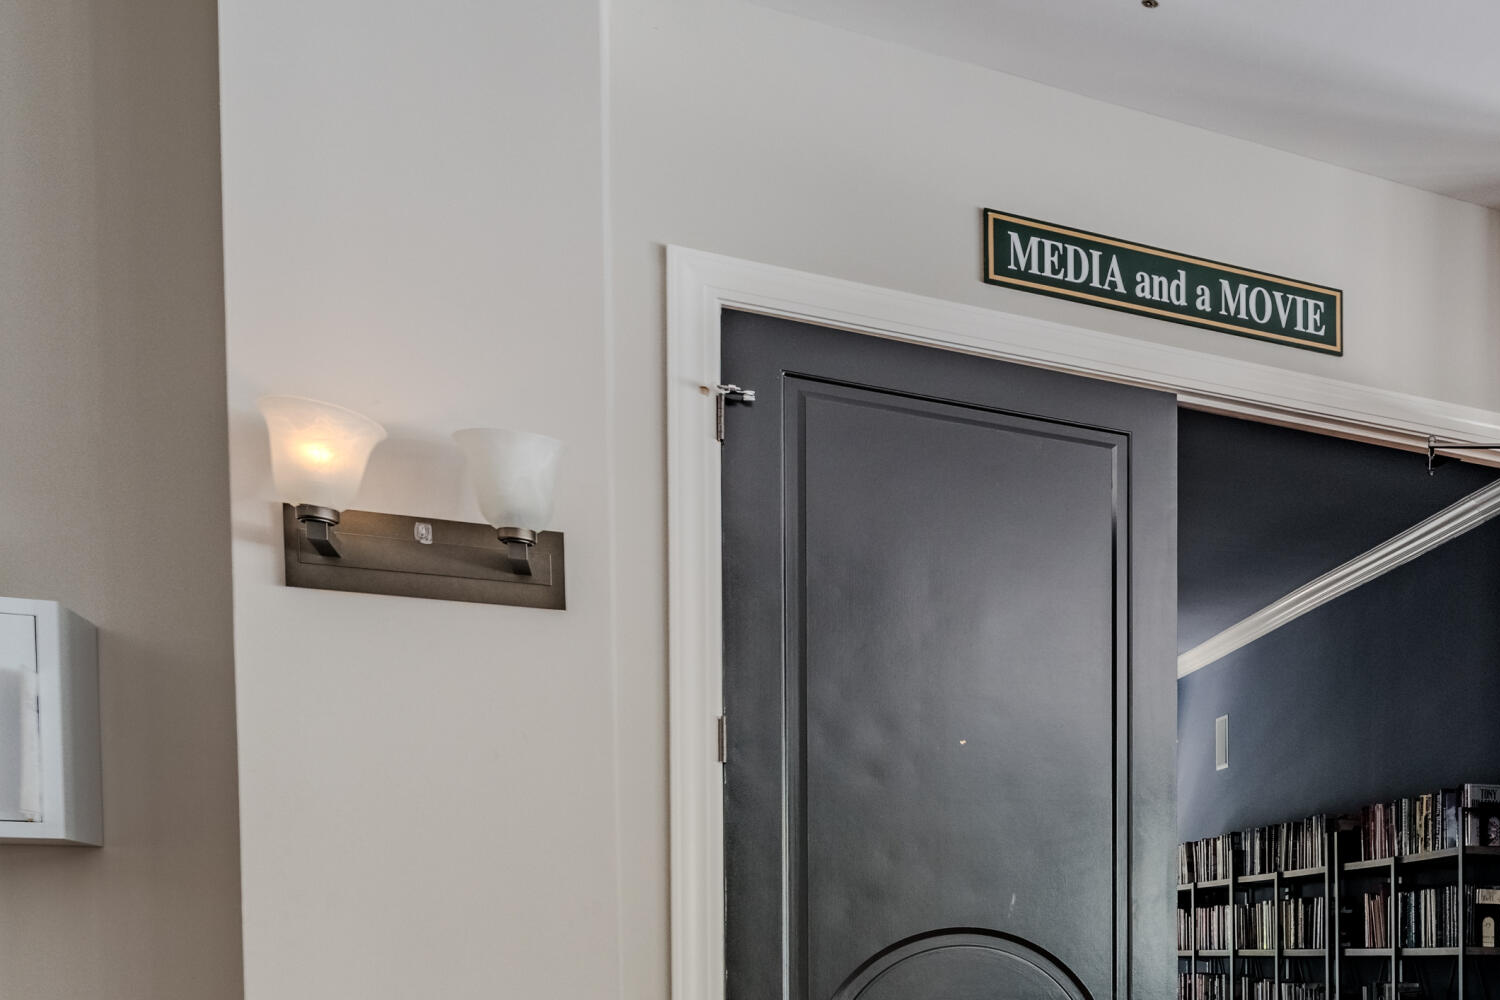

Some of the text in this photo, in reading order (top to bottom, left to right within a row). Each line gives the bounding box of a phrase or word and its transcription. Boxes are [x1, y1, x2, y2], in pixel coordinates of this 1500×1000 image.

[1007, 231, 1326, 336] MEDIA and a MOVIE
